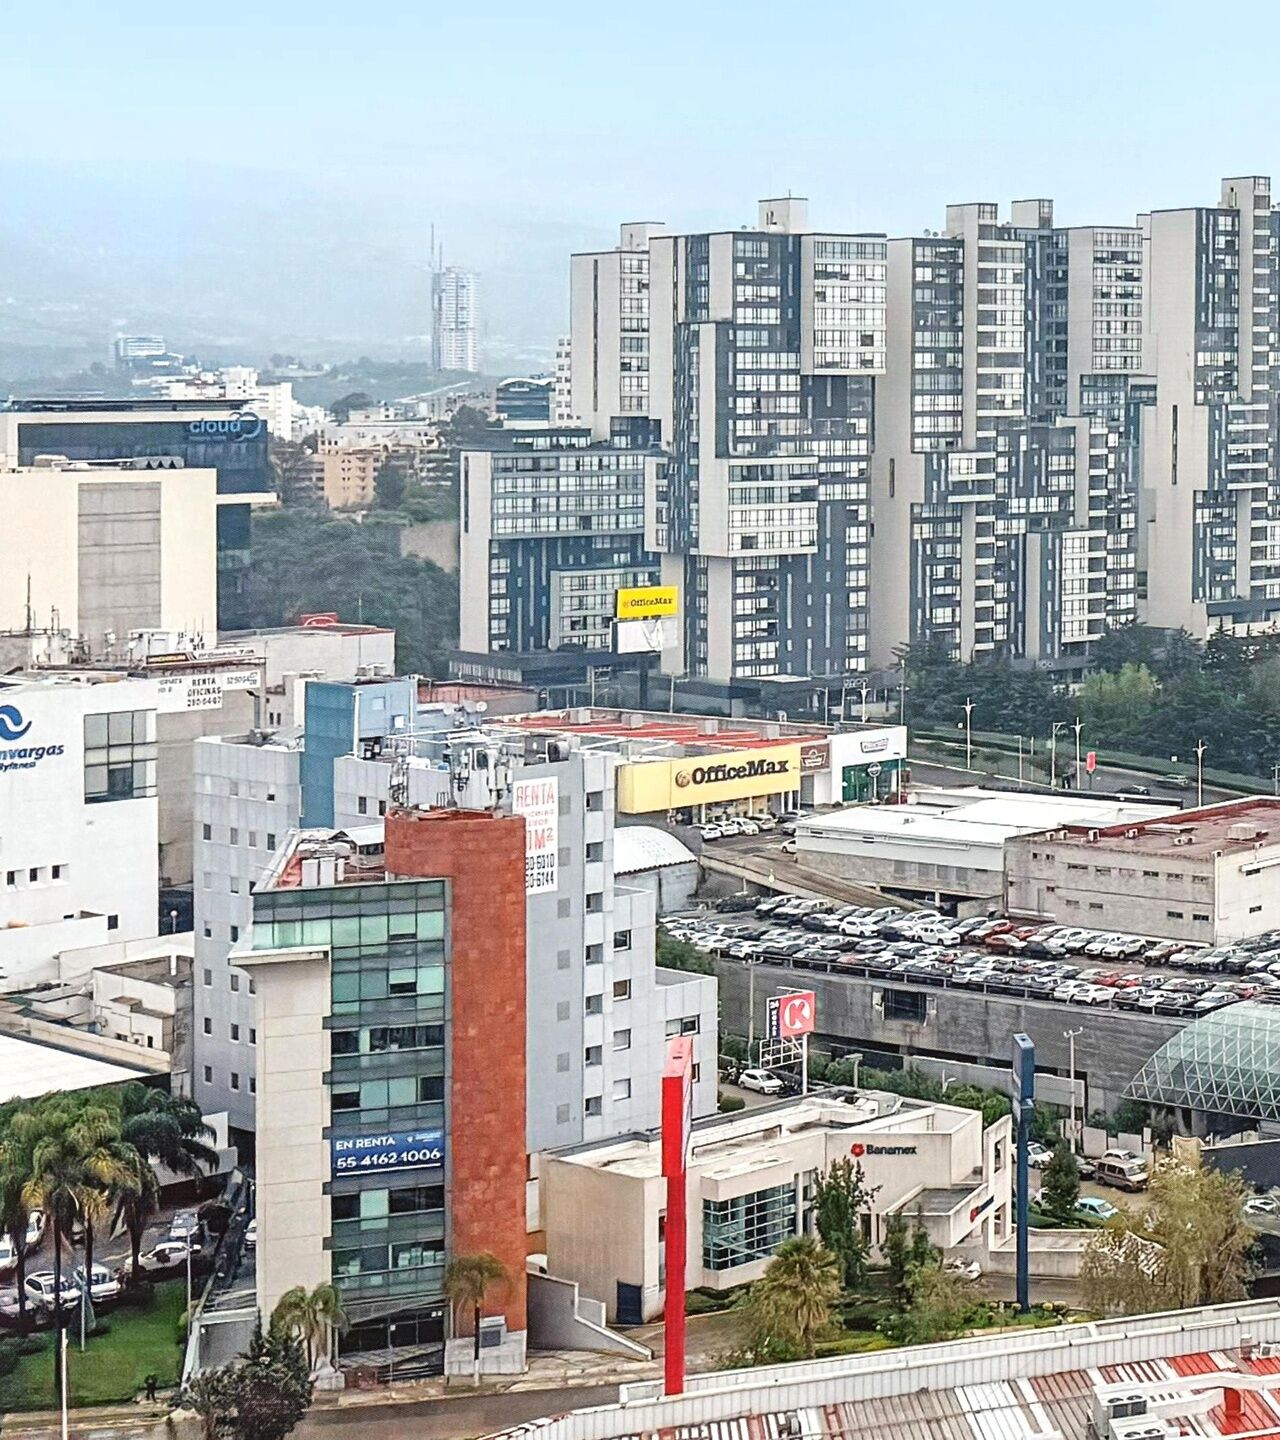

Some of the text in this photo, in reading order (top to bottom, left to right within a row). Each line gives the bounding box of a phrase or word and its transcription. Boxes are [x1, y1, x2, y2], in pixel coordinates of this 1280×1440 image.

[692, 760, 789, 785] OfficeMax
[516, 783, 555, 808] RENTA
[336, 1136, 396, 1151] EN RENTA
[866, 1144, 917, 1155] Banamex
[337, 1147, 441, 1169] 55 4162 1006
